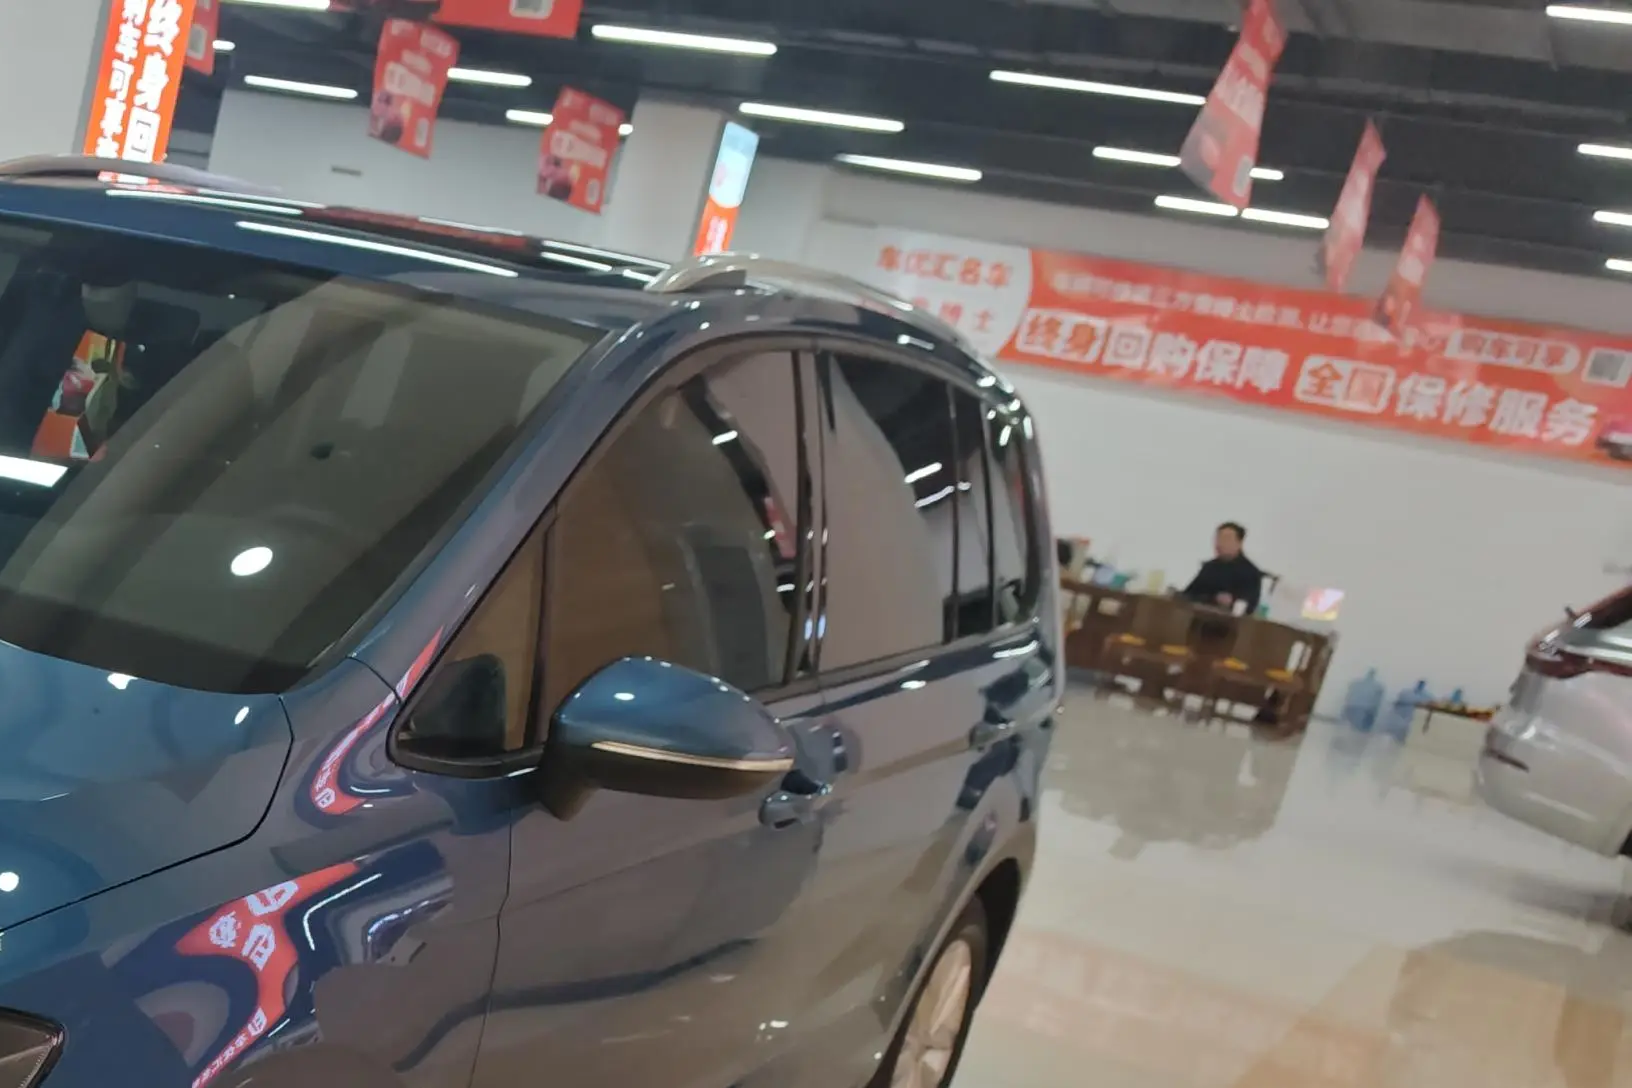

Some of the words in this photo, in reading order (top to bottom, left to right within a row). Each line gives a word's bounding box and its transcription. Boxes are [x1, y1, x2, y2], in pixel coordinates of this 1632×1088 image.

[1022, 311, 1290, 394] 终身回购保障
[1301, 358, 1599, 446] 全国保修服务
